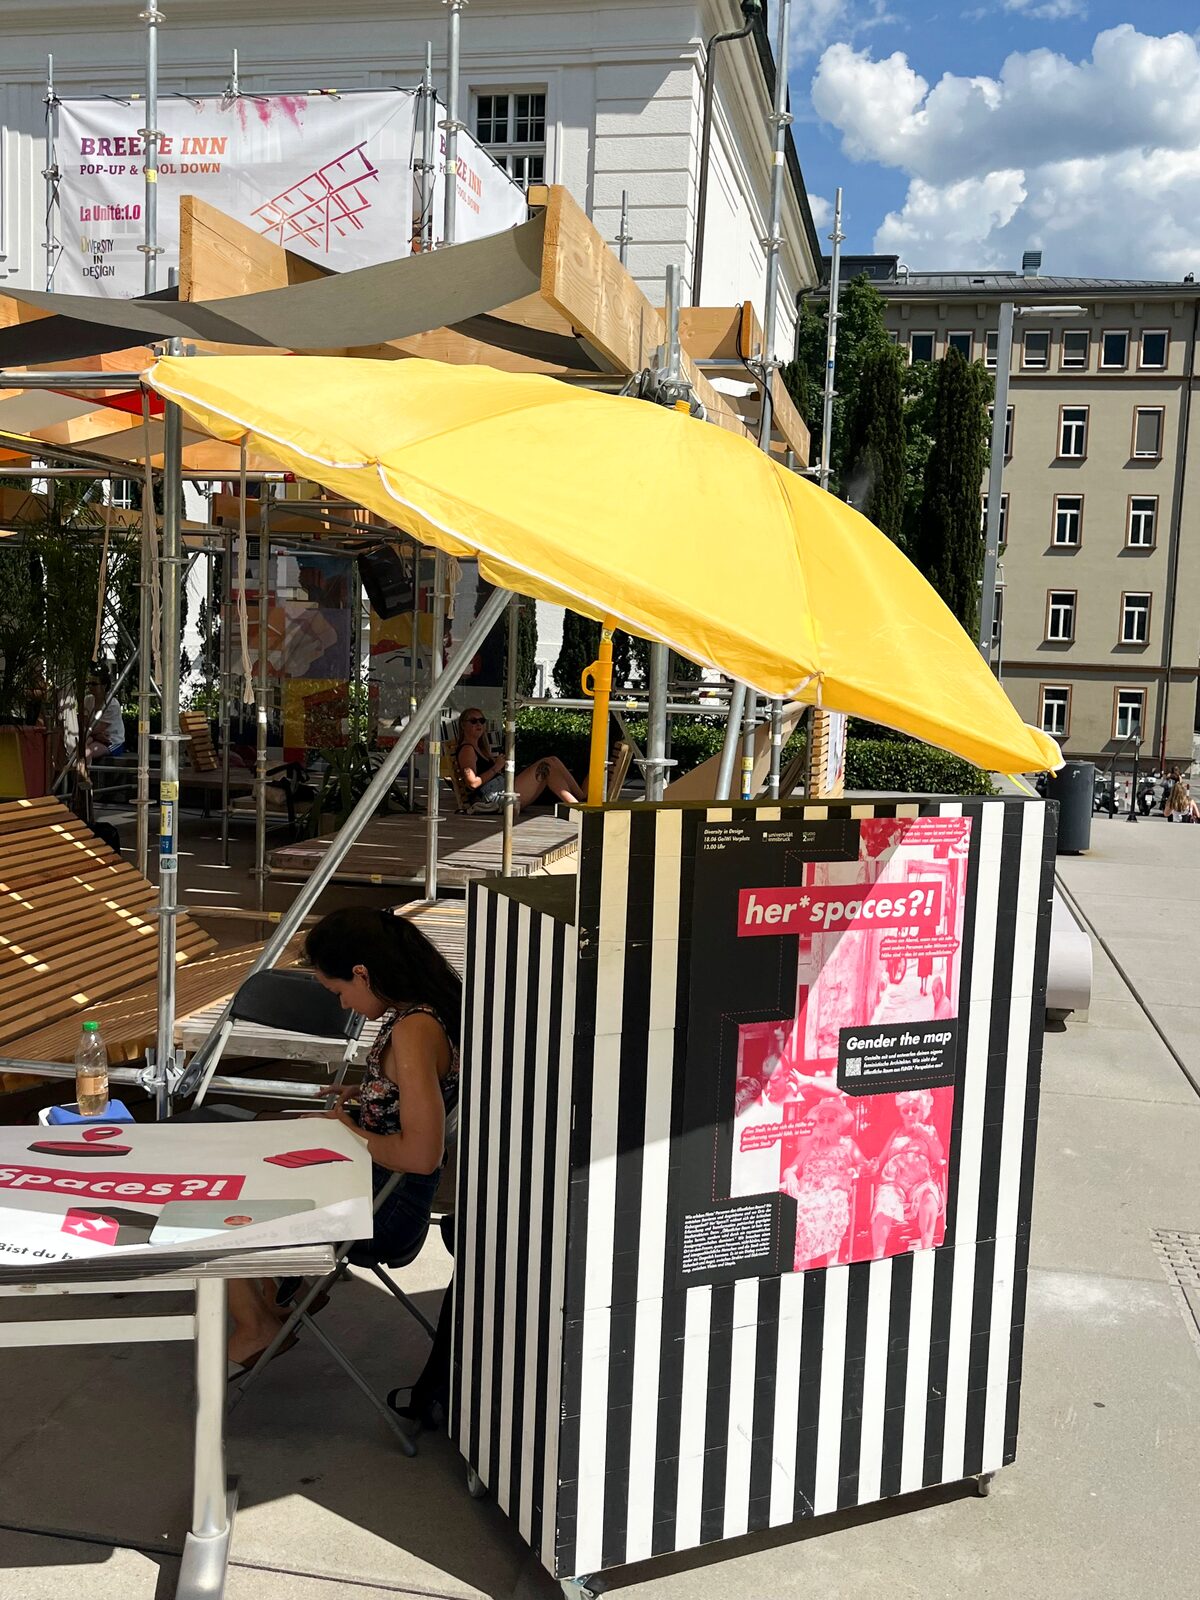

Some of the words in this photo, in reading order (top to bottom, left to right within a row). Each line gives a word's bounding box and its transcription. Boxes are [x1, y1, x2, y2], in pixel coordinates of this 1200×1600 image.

[181, 137, 228, 155] INN
[80, 164, 126, 175] POP-UP
[130, 165, 139, 175] &
[180, 163, 221, 174] DOWN
[80, 206, 91, 221] La
[93, 204, 141, 222] Unité:1.0
[80, 236, 114, 255] DIVERSITY
[93, 255, 103, 264] IN
[83, 265, 115, 279] DESIGN
[846, 1033, 898, 1051] Gender
[900, 1031, 920, 1046] the
[923, 1031, 952, 1046] map
[32, 1249, 57, 1259] du
